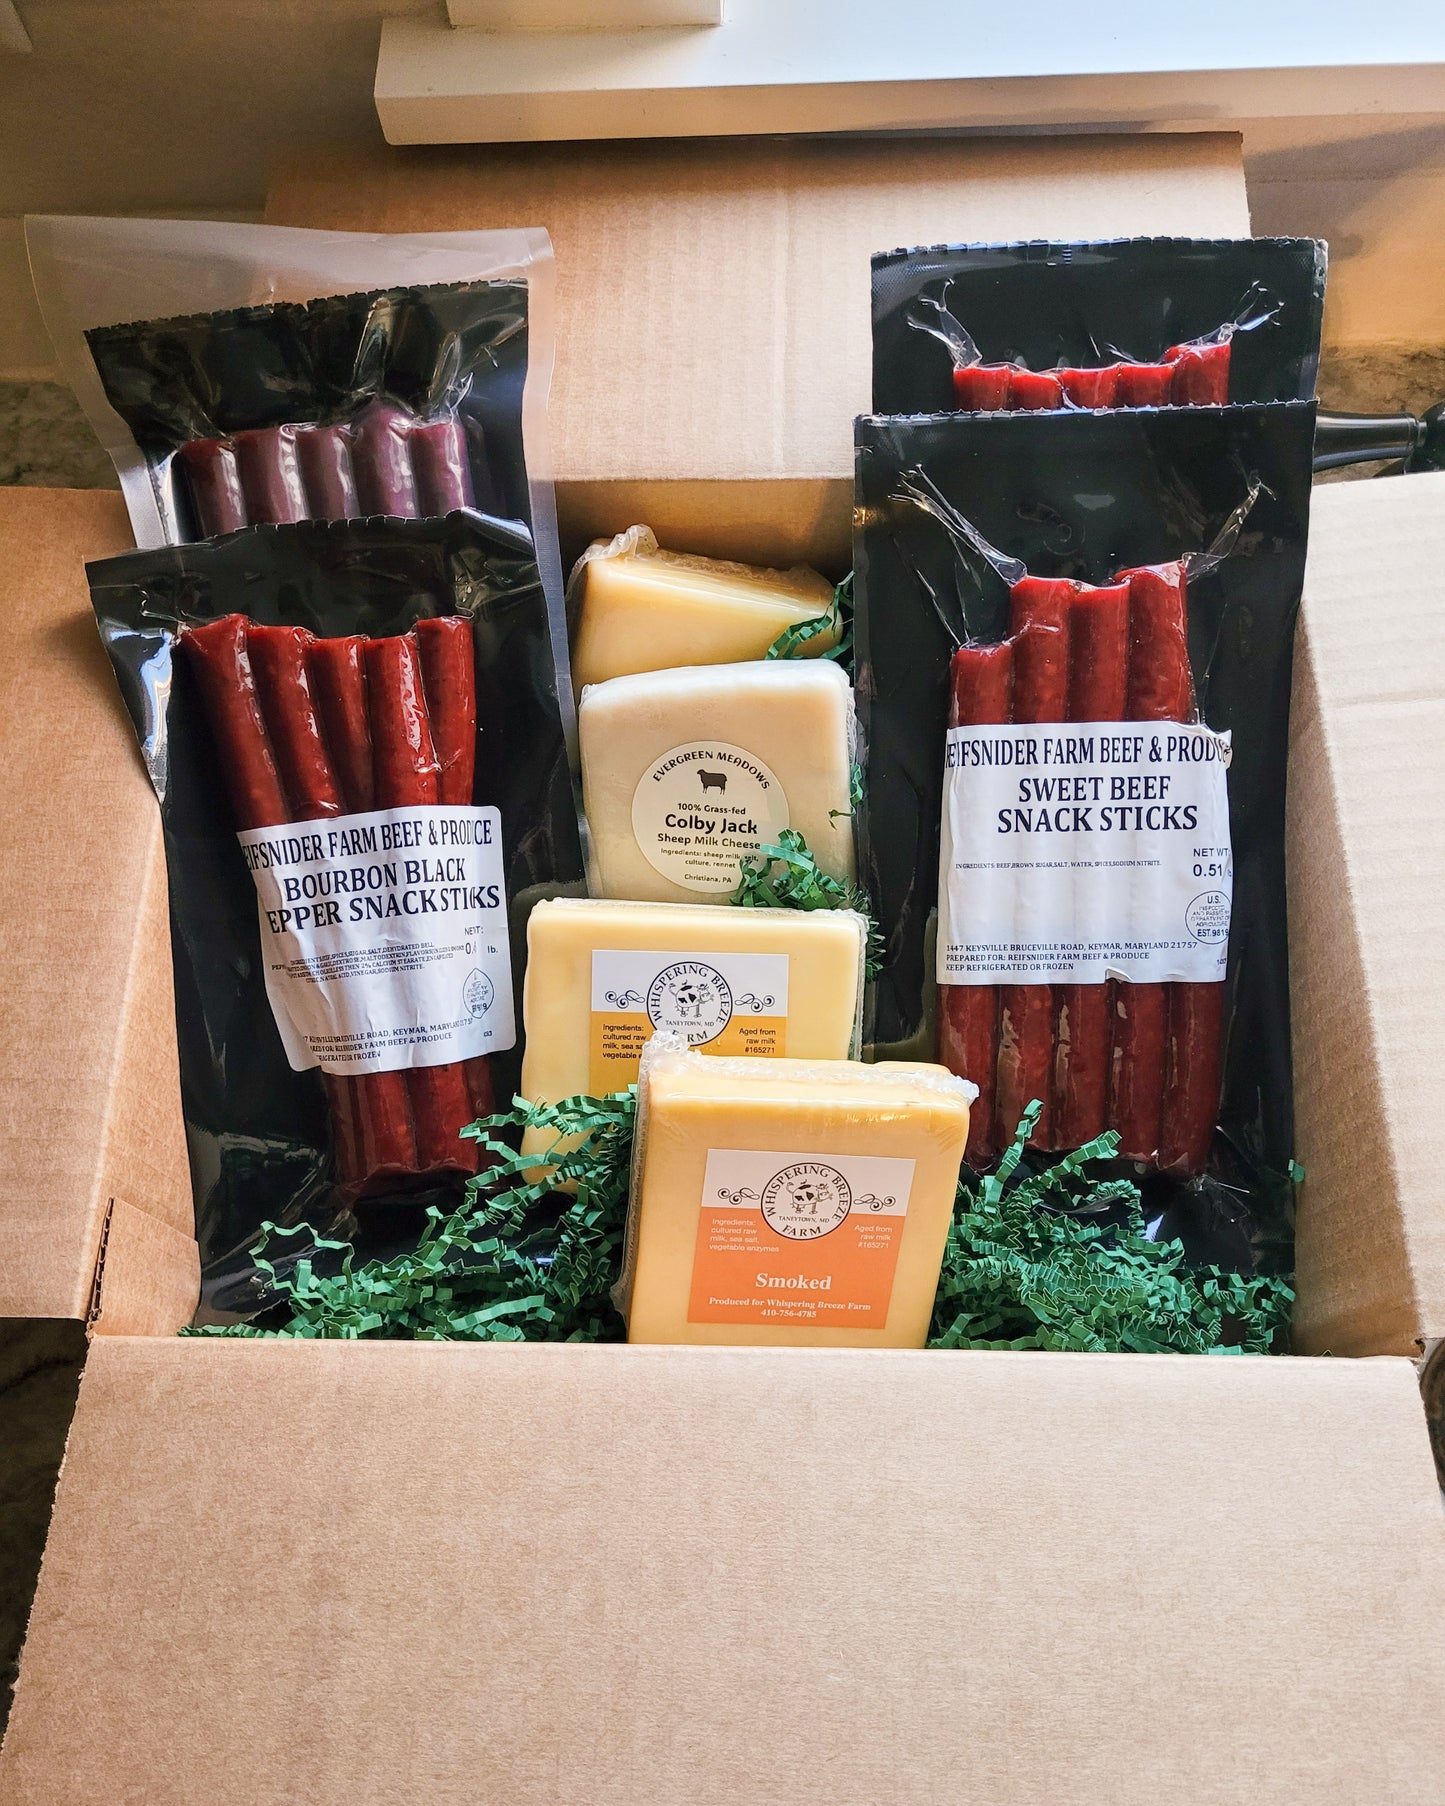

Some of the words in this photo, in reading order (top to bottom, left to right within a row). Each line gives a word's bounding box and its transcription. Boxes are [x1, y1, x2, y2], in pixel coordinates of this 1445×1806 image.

[1043, 737, 1094, 764] FARM
[1100, 736, 1144, 763] BEEF
[1148, 736, 1162, 763] &
[653, 751, 713, 782] EVERGREEN
[717, 752, 770, 790] MEADOWS
[1019, 777, 1103, 802] SWEET
[1110, 776, 1171, 800] BEEF
[678, 803, 701, 811] 100%
[704, 805, 746, 814] Grass-fed
[665, 814, 715, 834] Colby
[721, 819, 758, 834] Jack
[997, 807, 1092, 834] SNACK
[1100, 805, 1198, 831] STICKS
[328, 827, 377, 858] FARM
[381, 821, 423, 851] BEEF
[428, 820, 438, 846] &
[658, 834, 691, 845] Sheep
[695, 837, 718, 846] Milk
[722, 838, 760, 849] Cheese
[661, 848, 702, 857] Ingredients:
[1193, 848, 1214, 857] NET
[685, 859, 711, 867] culture,
[1193, 864, 1223, 877] 0.51
[284, 863, 398, 901] BOURBON
[404, 858, 466, 885] BLACK
[684, 874, 721, 882] Christiana,
[1207, 896, 1221, 904] U.S.
[349, 889, 438, 922] SNACK
[487, 945, 498, 953] lb.
[1125, 942, 1169, 950] MARYLAND
[650, 964, 709, 1022] WHISPERING
[711, 974, 730, 1025] BREEZE
[367, 1031, 390, 1039] ROAD,
[393, 1026, 428, 1036] KEYMAR,
[603, 1024, 644, 1032] Ingredients:
[739, 1028, 758, 1036] Aged
[365, 1041, 385, 1049] FARM
[417, 1032, 452, 1043] PRODUCE
[603, 1033, 631, 1041] cultured
[603, 1042, 619, 1050] milk,
[744, 1046, 775, 1054] #165271
[603, 1052, 637, 1060] vegetable
[766, 1165, 830, 1217] WHISPERING
[831, 1177, 848, 1222] BREEZE
[782, 1224, 822, 1237] FARM
[854, 1224, 873, 1233] Aged
[875, 1225, 893, 1233] from
[710, 1235, 727, 1243] milk,
[744, 1236, 760, 1244] salt,
[876, 1233, 892, 1241] milk
[709, 1244, 745, 1252] vegetable
[858, 1241, 889, 1249] #165271
[755, 1272, 832, 1290] Smoked
[709, 1297, 750, 1306] Produced
[752, 1298, 766, 1306] for
[767, 1299, 815, 1309] Whispering
[817, 1301, 846, 1310] Breeze
[848, 1302, 871, 1310] Farm
[761, 1309, 817, 1318] 410-756-4785
